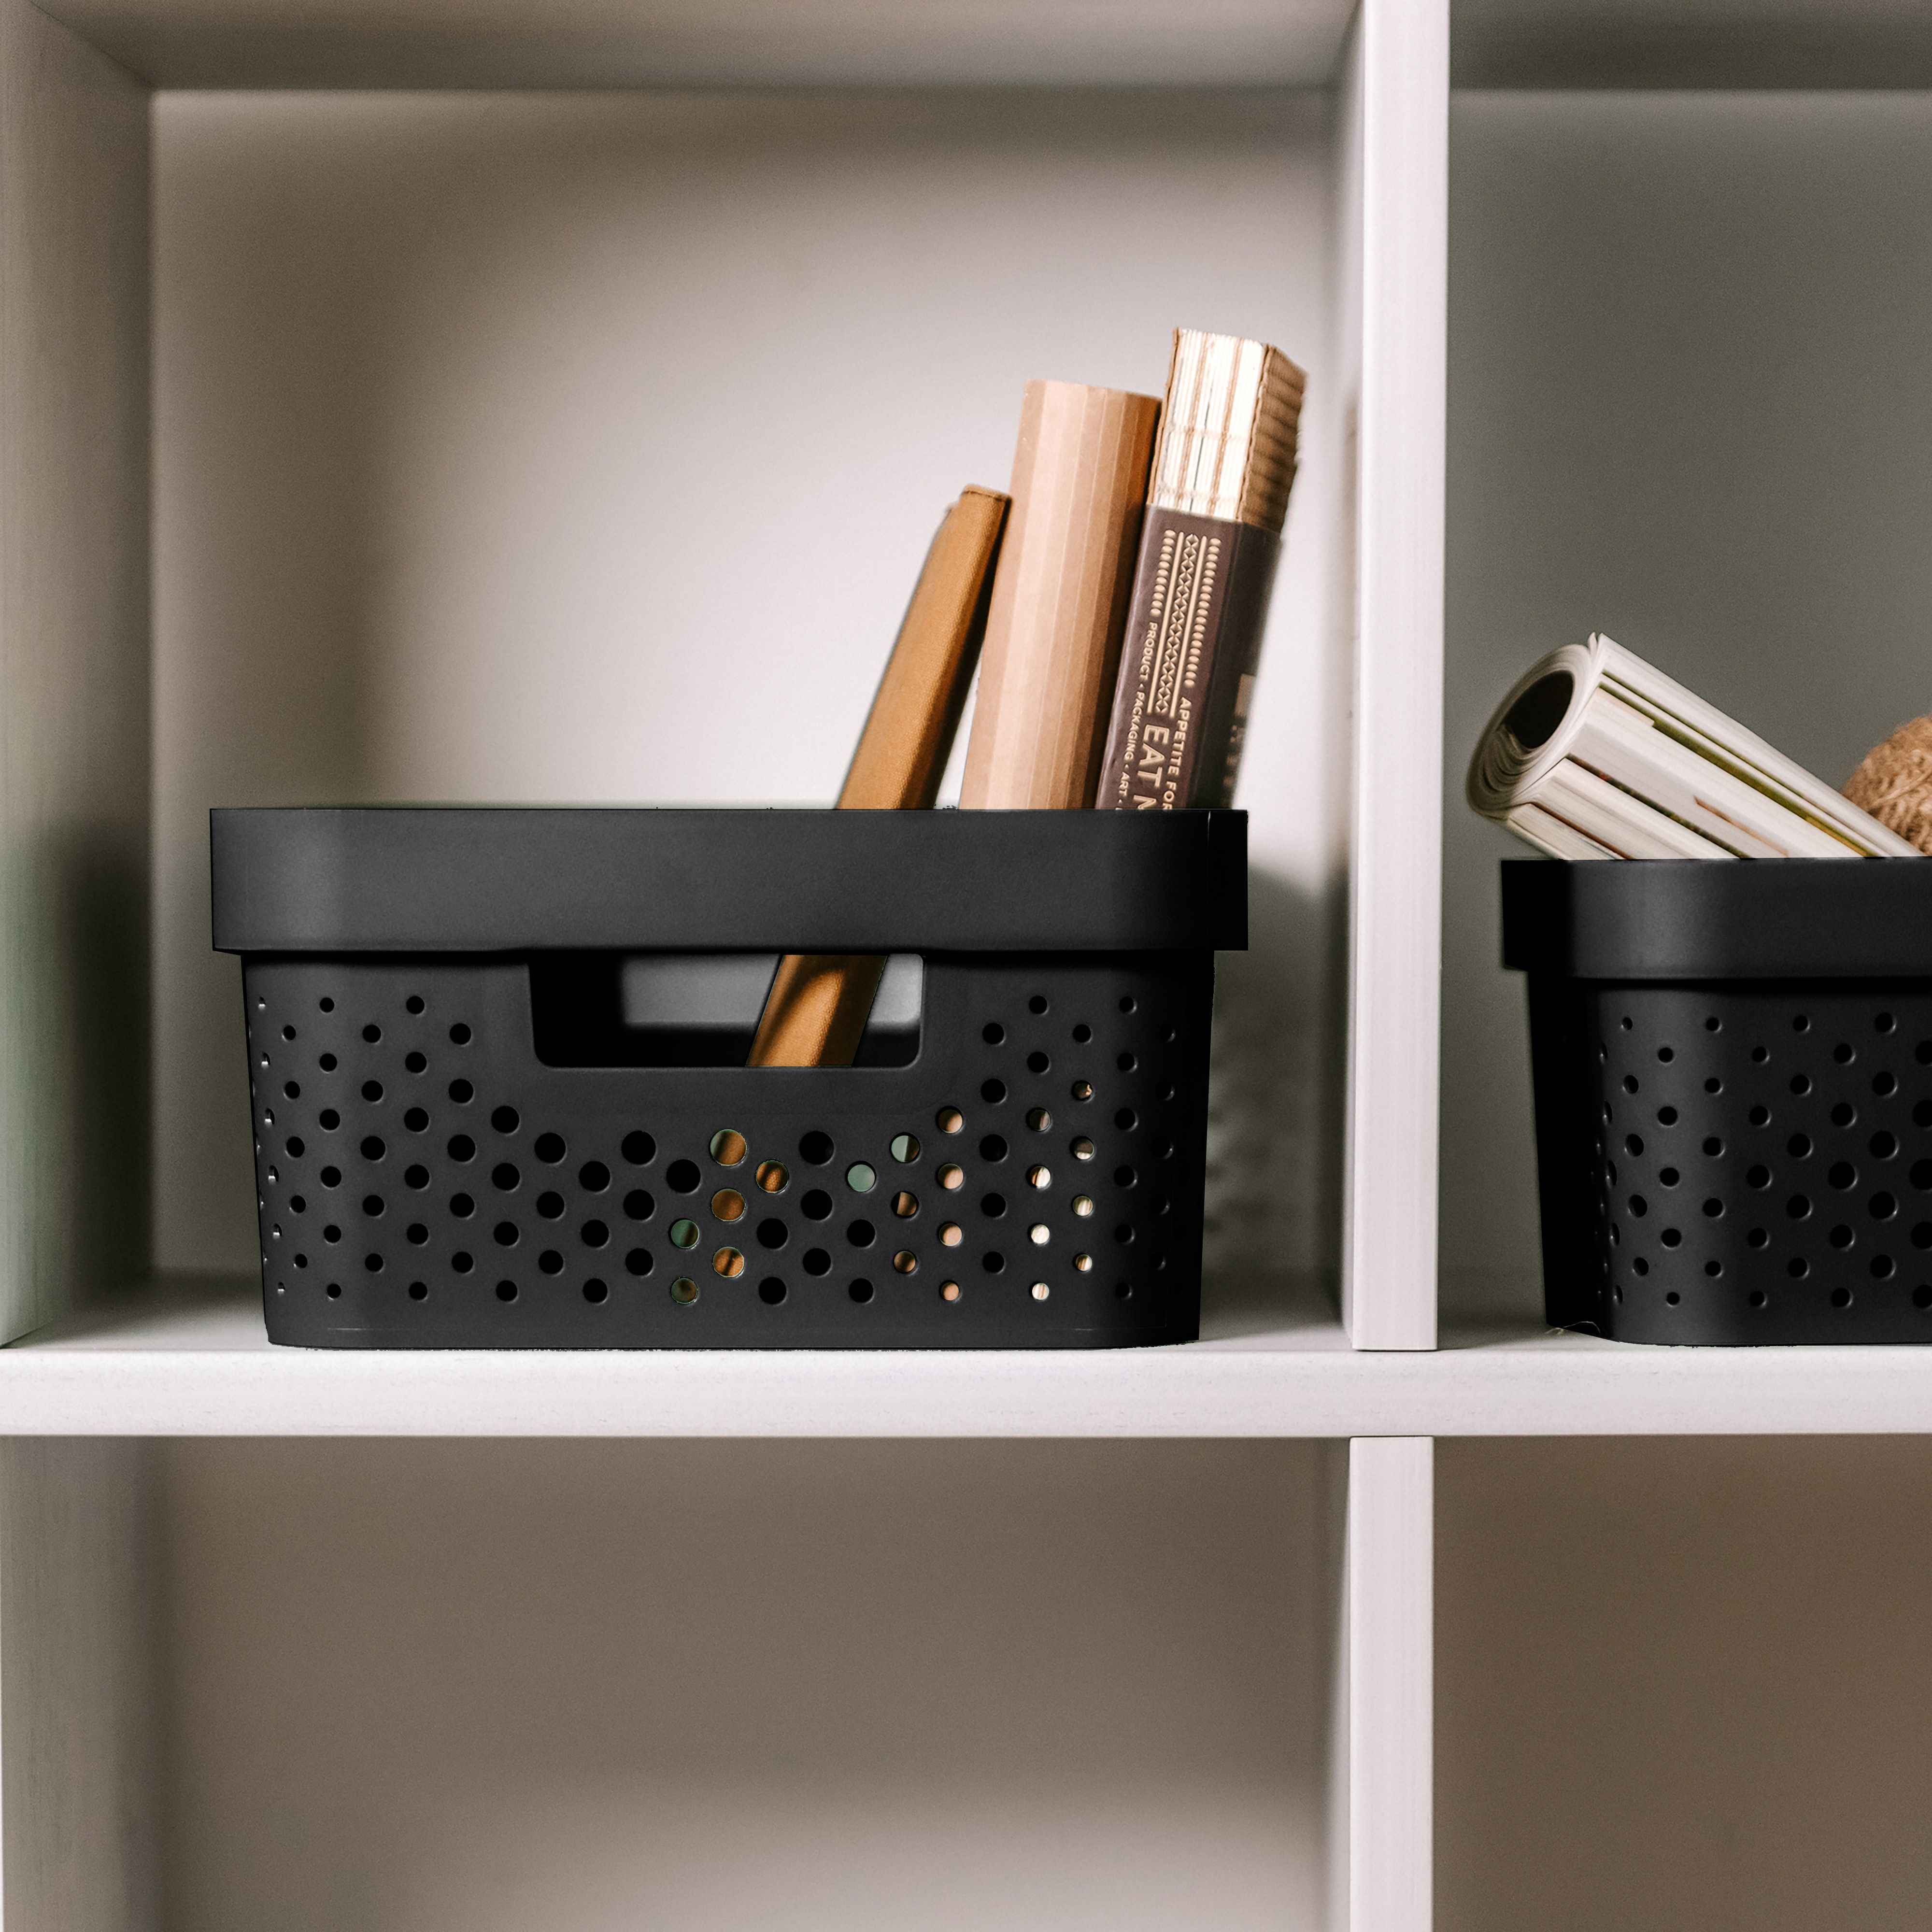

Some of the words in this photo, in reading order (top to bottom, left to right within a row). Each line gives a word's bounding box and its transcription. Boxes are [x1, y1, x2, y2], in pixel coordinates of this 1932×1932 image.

[1138, 622, 1158, 681] PRODUCT
[1124, 691, 1145, 760] PACKAGING
[1137, 724, 1170, 788] EAT
[1167, 697, 1192, 776] APPETITE
[1119, 771, 1130, 796] ART
